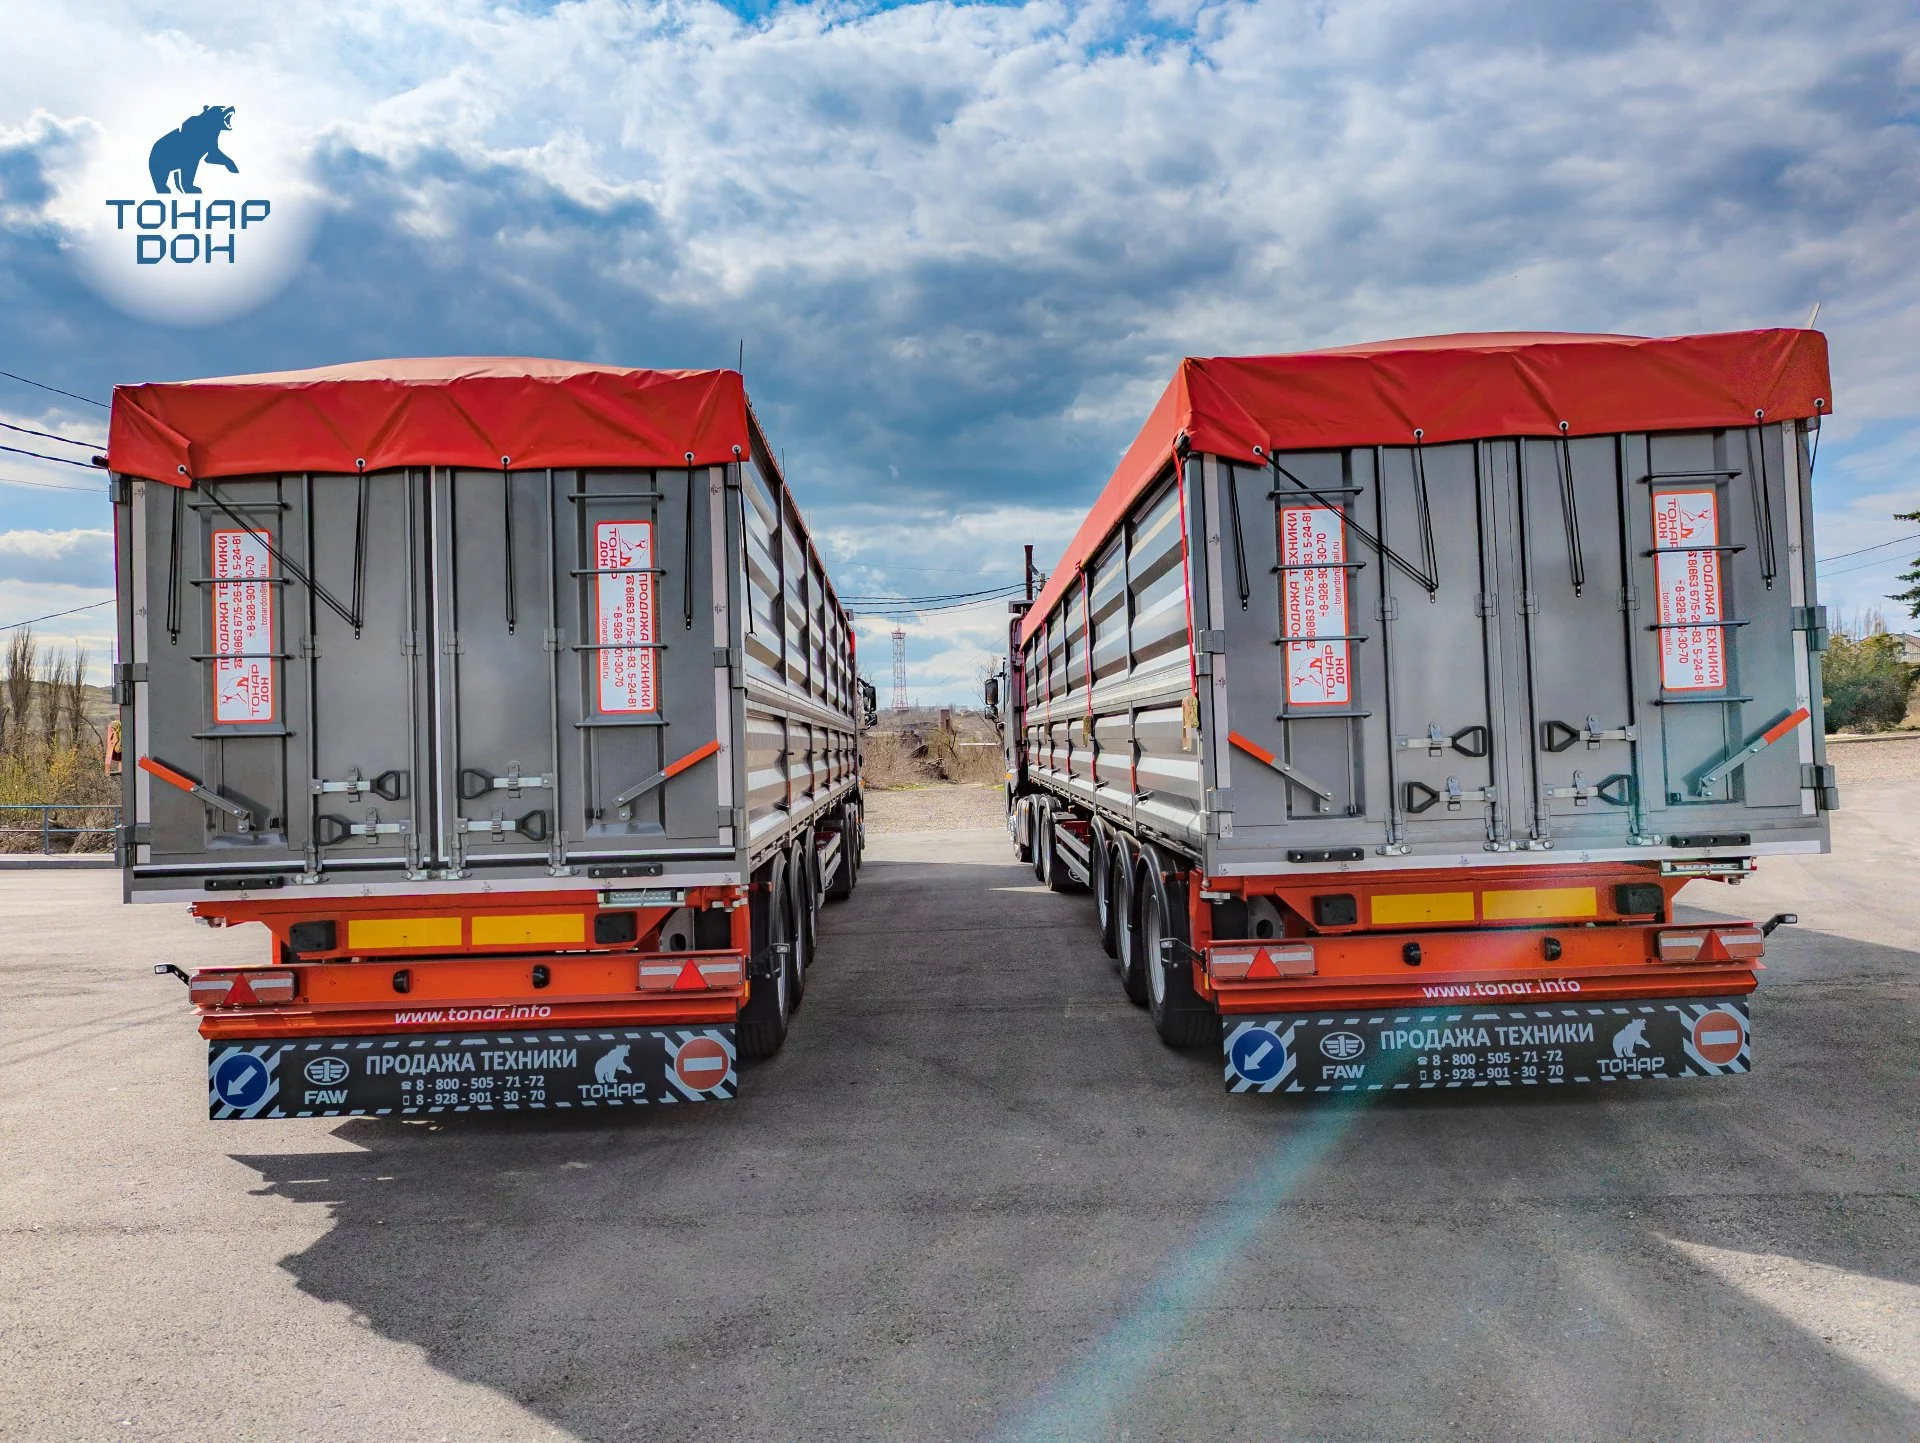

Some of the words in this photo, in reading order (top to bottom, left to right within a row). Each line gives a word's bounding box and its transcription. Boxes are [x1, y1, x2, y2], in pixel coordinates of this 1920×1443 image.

[1302, 513, 1312, 547] 5-24-81
[1658, 512, 1667, 538] ДОН
[233, 536, 241, 569] 5-24-81
[1304, 551, 1315, 605] 67)5-2683,
[1317, 534, 1328, 610] 8-928-90-30-70
[1688, 560, 1698, 587] 8(863
[246, 556, 255, 630] 8-928-901-0-70
[625, 587, 634, 614] 8(863
[639, 574, 648, 640] ПРОДАЖА
[1306, 610, 1316, 637] 8(863
[1663, 592, 1673, 655] tonardonmail.ru
[1690, 591, 1701, 645] 67)5-2-83,
[614, 613, 623, 687] 8-928-01-30-70
[1707, 620, 1719, 683] ЕХНИКИ
[1325, 645, 1335, 698] ТОНАР
[1336, 658, 1344, 684] ДОН
[1693, 649, 1703, 684] 5-24-81
[628, 673, 636, 707] 5-24-81
[1423, 978, 1580, 998] www.tonar.info
[395, 1005, 551, 1024] www.tonar.info
[1381, 1028, 1490, 1050] ПРОДАЖА
[1495, 1023, 1594, 1046] ТЕХНИКИ
[366, 1053, 475, 1075] ПРОДАЖА
[480, 1049, 577, 1070] ТЕХНИКИ
[1322, 1065, 1365, 1079] FAW
[1597, 1057, 1664, 1073] ТОНАР
[304, 1090, 348, 1104] FAW
[578, 1082, 645, 1098] ТОНАР
